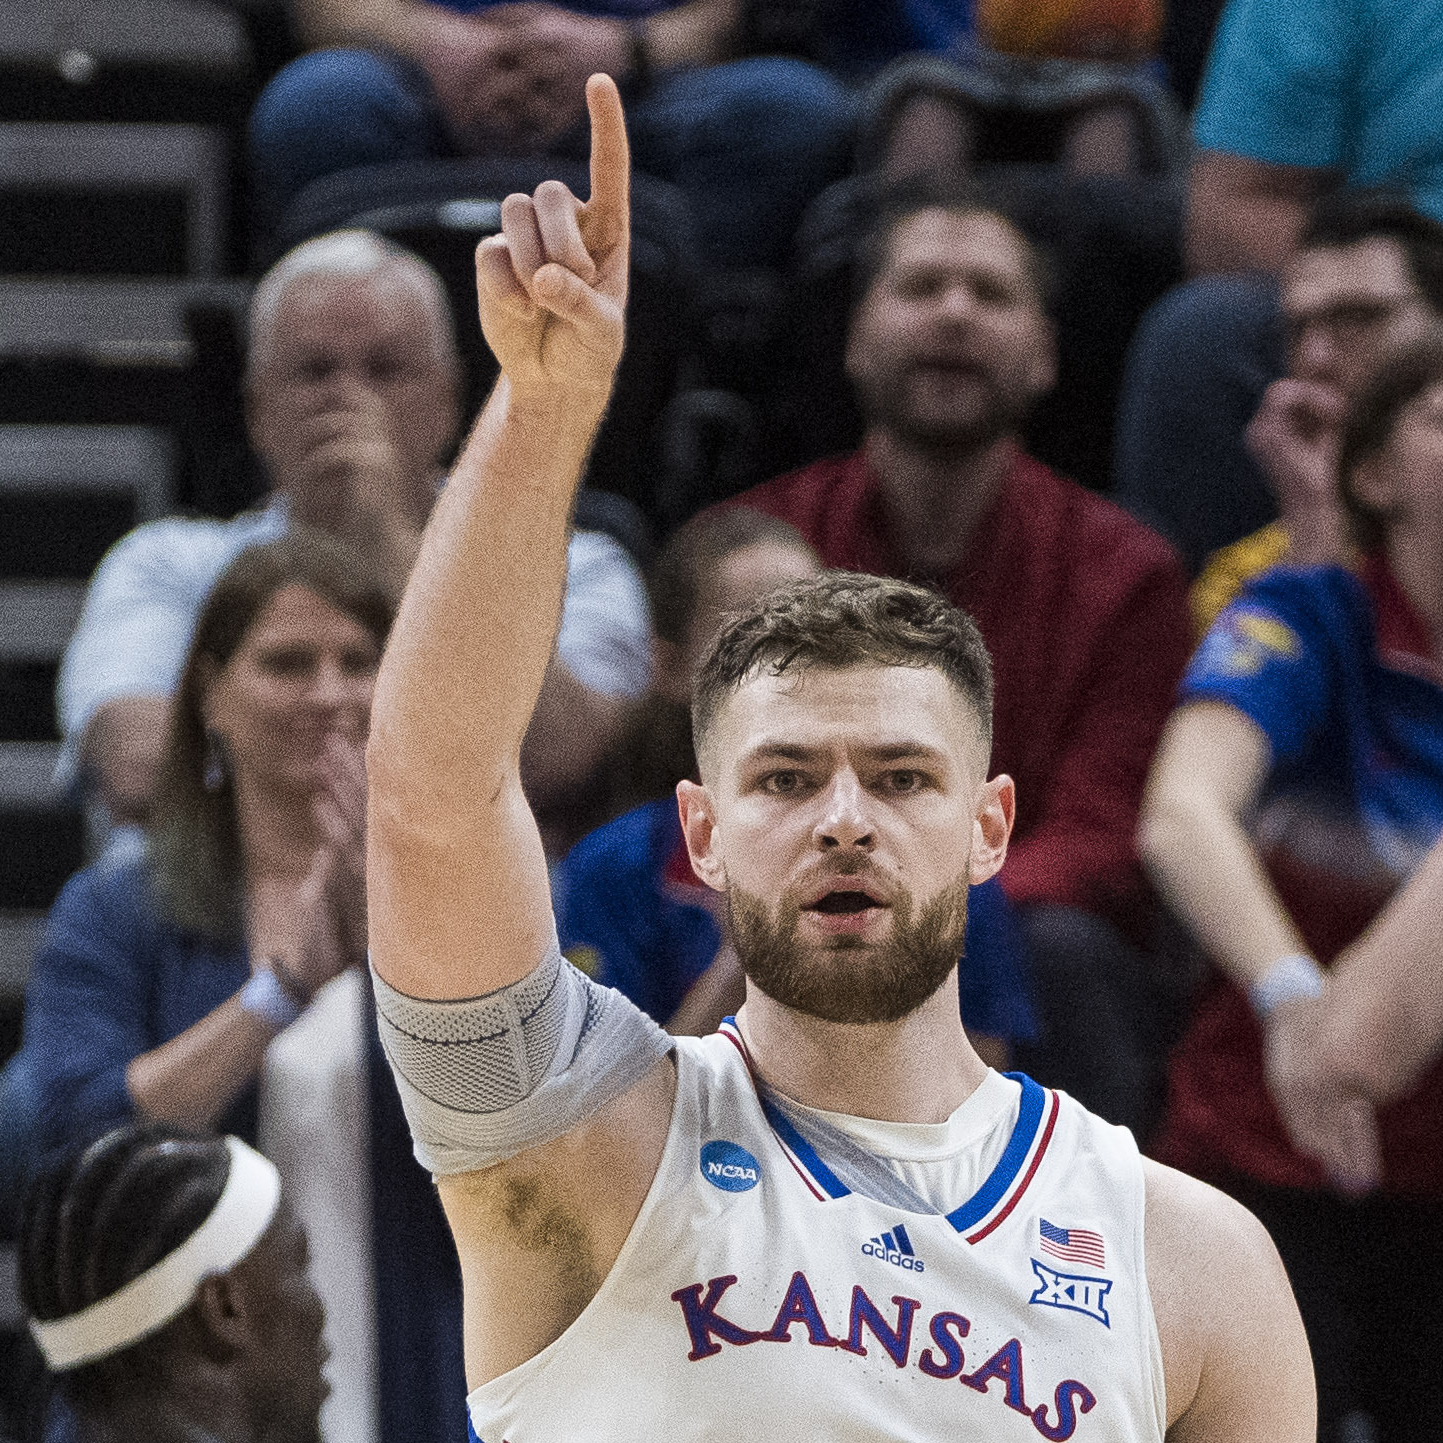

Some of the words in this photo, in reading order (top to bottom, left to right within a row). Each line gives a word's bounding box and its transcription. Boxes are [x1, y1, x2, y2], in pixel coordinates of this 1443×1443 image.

[708, 1161, 757, 1181] NCAA
[861, 1242, 925, 1272] adidas
[671, 1271, 1096, 1443] KANSAS
